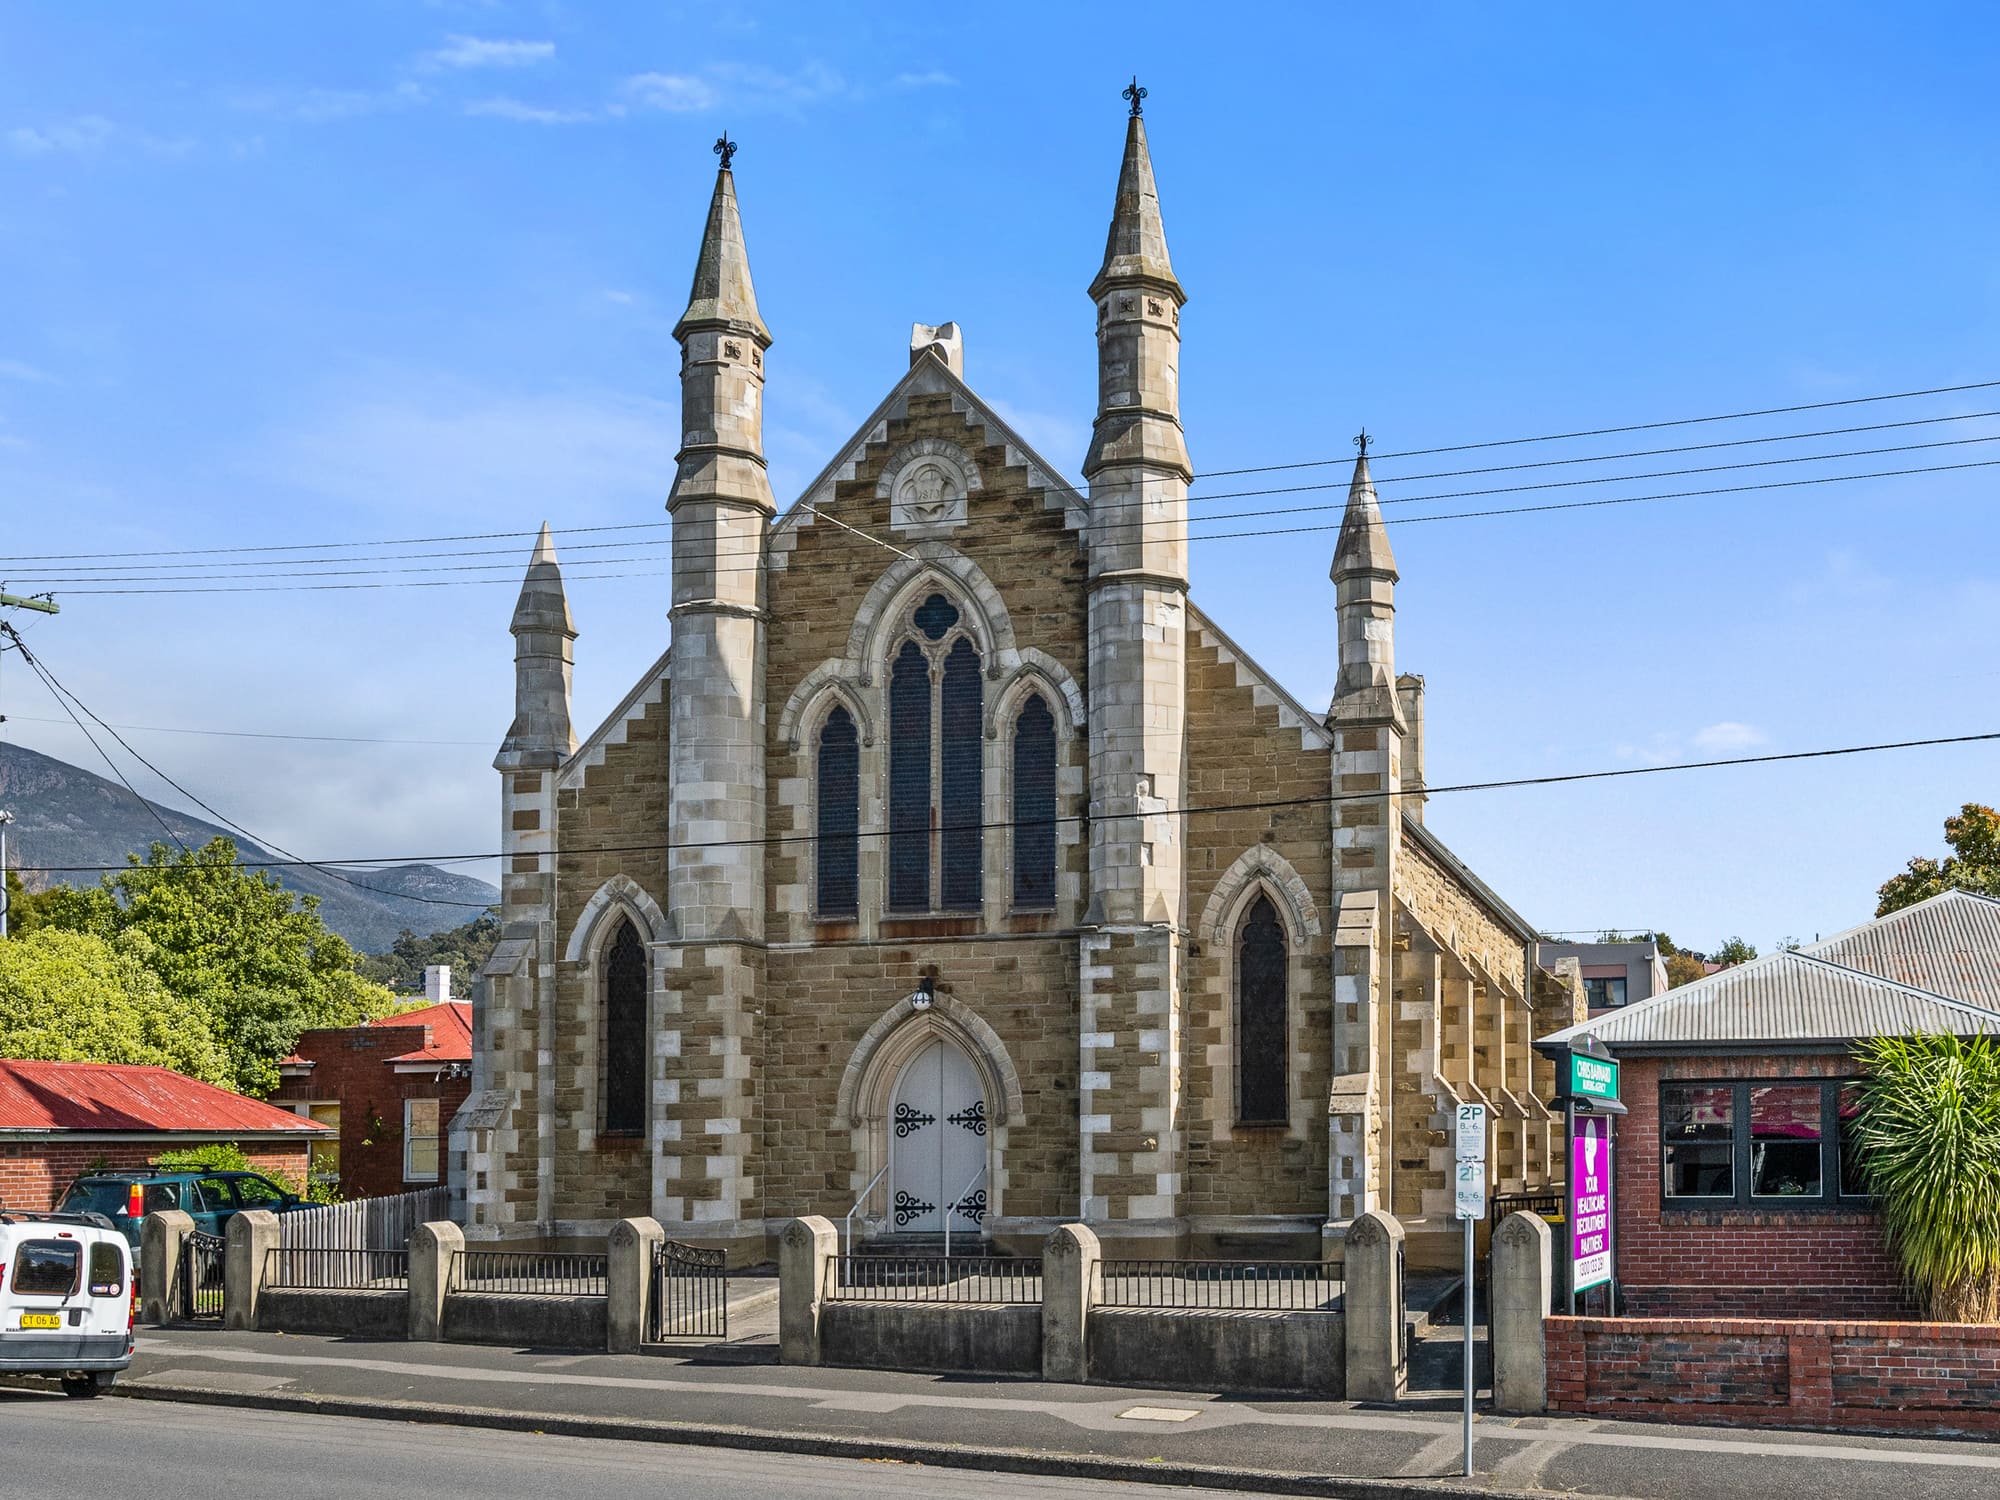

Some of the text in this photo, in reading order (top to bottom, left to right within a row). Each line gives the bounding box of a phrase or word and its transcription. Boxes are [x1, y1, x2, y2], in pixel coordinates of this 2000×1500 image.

[1460, 1107, 1483, 1120] 2P
[1459, 1167, 1482, 1181] 2P
[1585, 1175, 1598, 1193] YOUR
[23, 1315, 33, 1325] CT
[50, 1316, 60, 1326] AD
